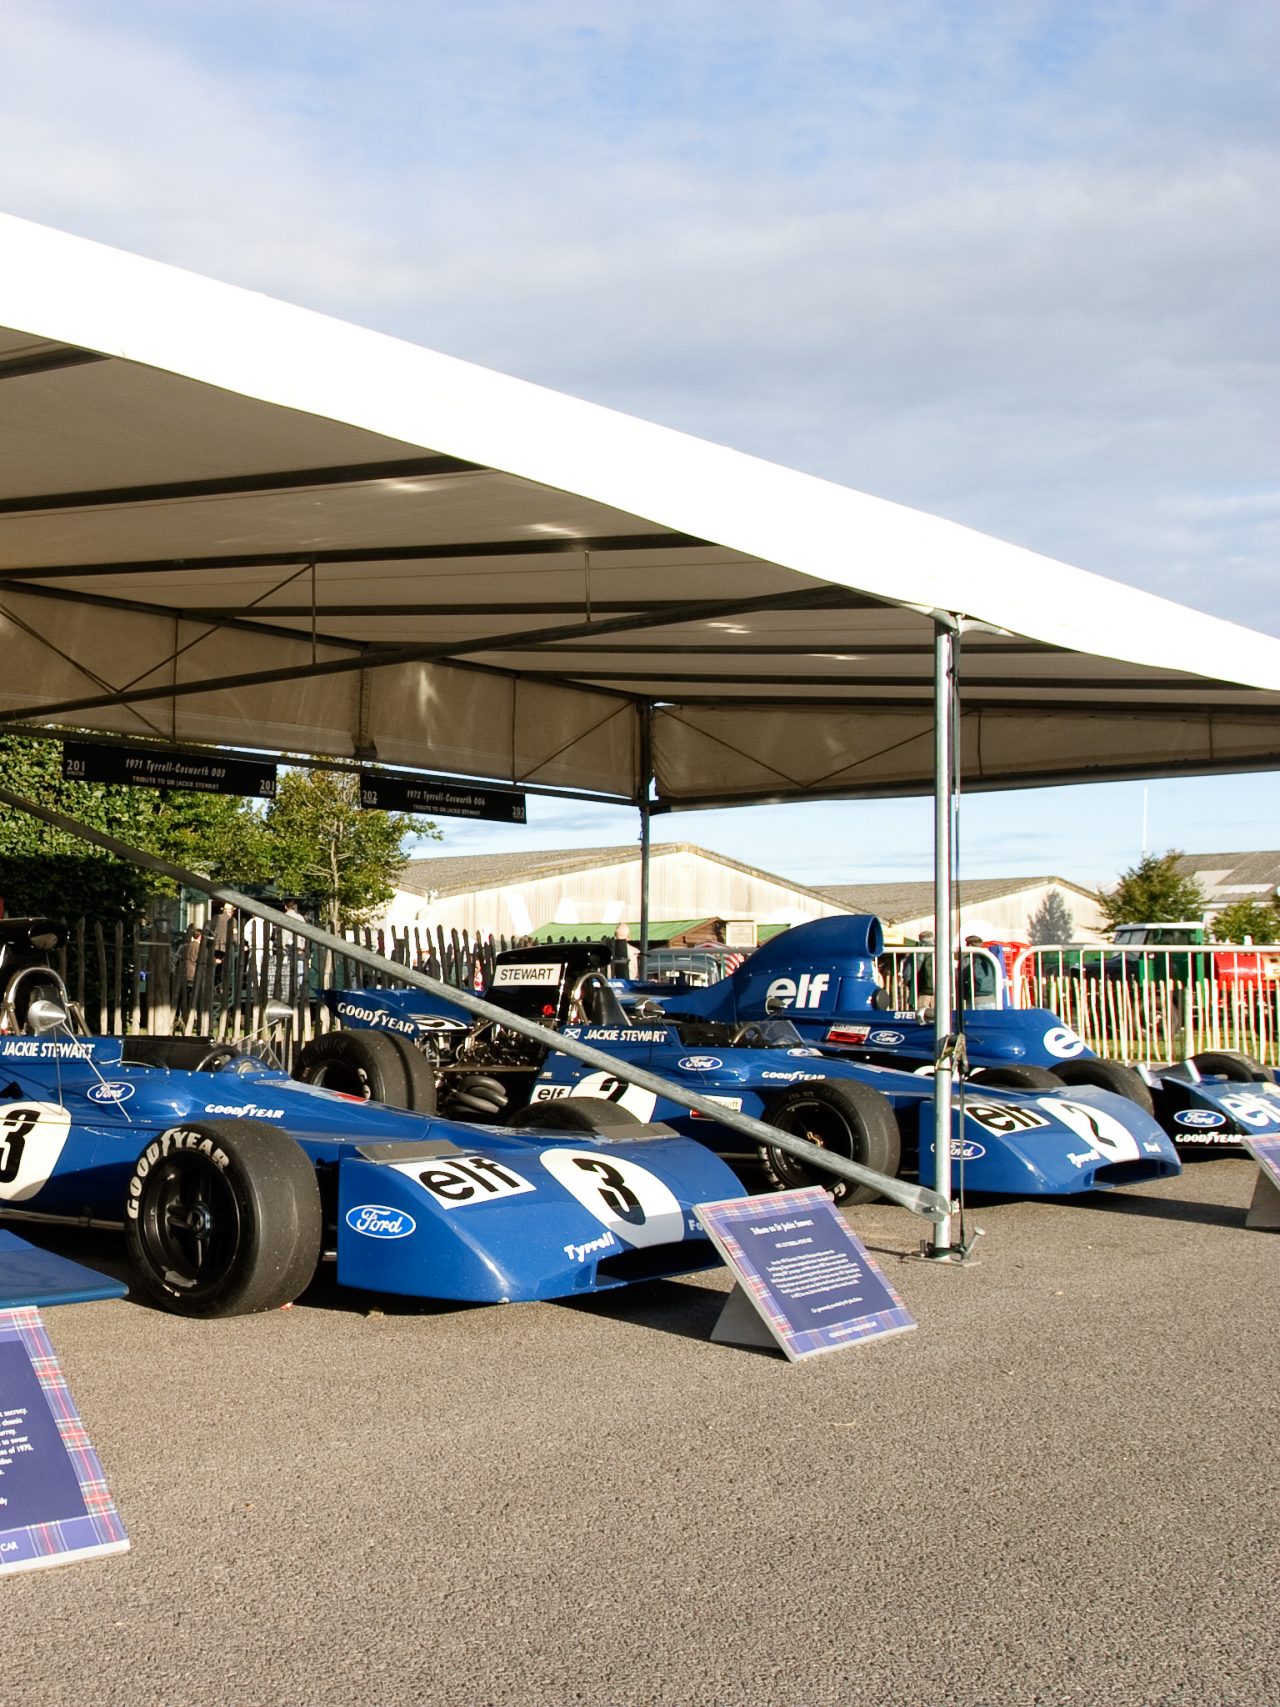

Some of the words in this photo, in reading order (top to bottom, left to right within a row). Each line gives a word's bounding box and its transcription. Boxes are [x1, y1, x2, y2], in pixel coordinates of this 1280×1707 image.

[67, 759, 86, 772] 201
[125, 758, 144, 769] 1971
[146, 760, 209, 776] Tyrrell-Cosworth
[260, 779, 275, 791] 201
[362, 790, 378, 801] 202
[500, 968, 554, 981] STEWART
[767, 973, 830, 1009] elf
[337, 1002, 415, 1034] GOODYEAR
[584, 1029, 620, 1041] JACKIE
[620, 1030, 668, 1043] STEWART
[2, 1042, 39, 1057] JACKIE
[40, 1042, 95, 1059] STEWART
[684, 1056, 715, 1069] Ford
[95, 1083, 125, 1099] Ford
[538, 1086, 565, 1100] elf
[205, 1104, 285, 1119] GOODYEAR
[967, 1104, 1042, 1131] elf
[1184, 1112, 1215, 1125] Ford
[1060, 1103, 1117, 1148] 2
[127, 1127, 229, 1219] GOODYEAR
[420, 1158, 520, 1200] elf
[573, 1158, 645, 1225] 3
[356, 1210, 404, 1234] Ford
[688, 1220, 704, 1231] Fo
[564, 1232, 615, 1262] Tyrrell
[0, 1541, 18, 1551] CAR
